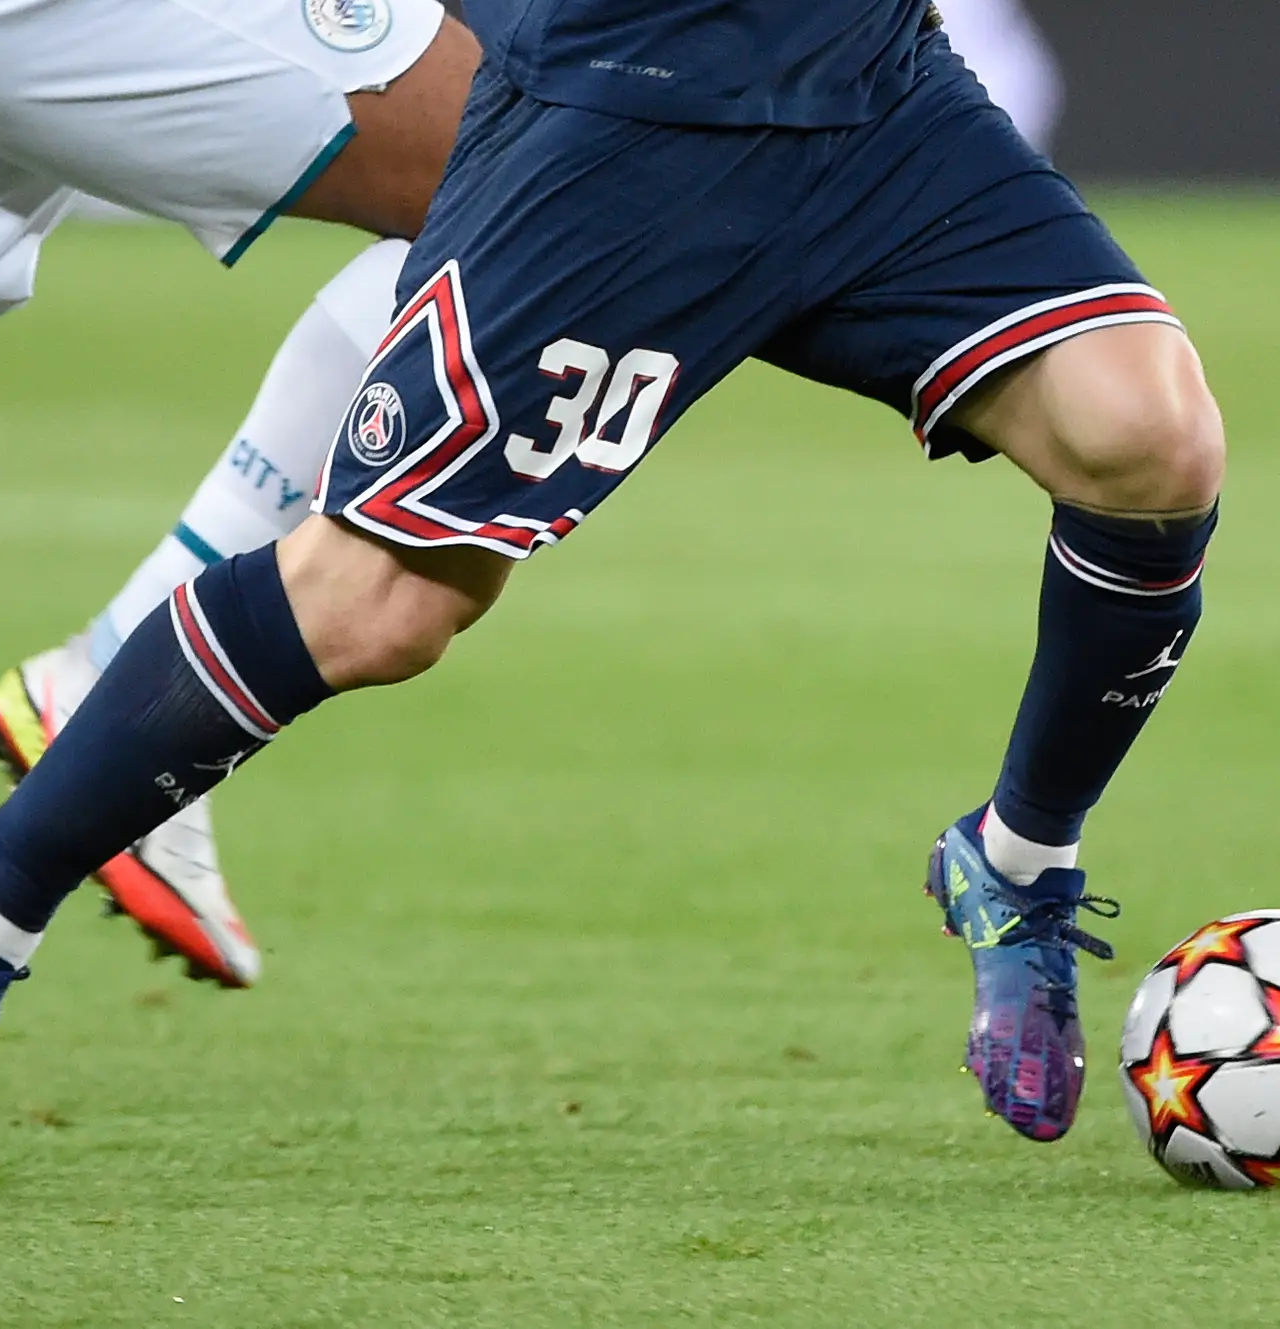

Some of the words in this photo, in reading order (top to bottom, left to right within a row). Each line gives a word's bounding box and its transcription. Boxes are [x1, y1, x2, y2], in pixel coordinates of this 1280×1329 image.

[366, 386, 402, 418] PARIS
[504, 337, 681, 481] 30
[231, 439, 304, 510] CITY
